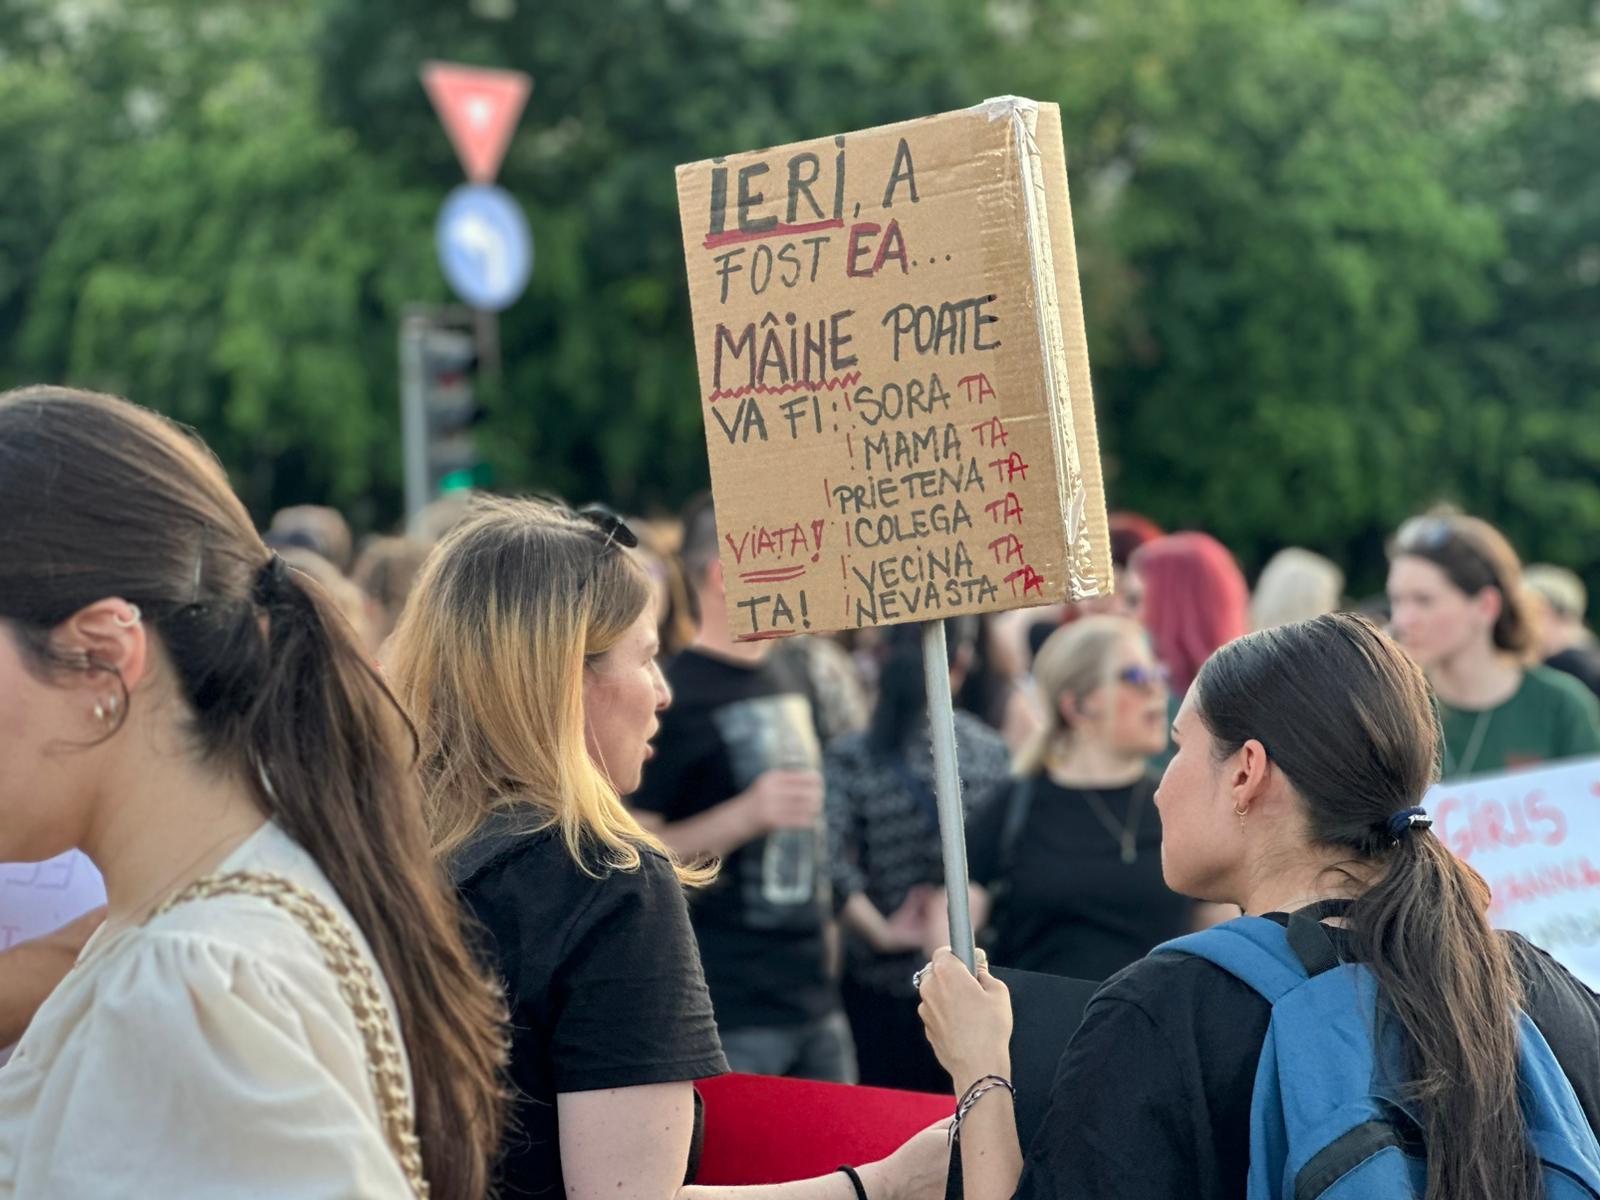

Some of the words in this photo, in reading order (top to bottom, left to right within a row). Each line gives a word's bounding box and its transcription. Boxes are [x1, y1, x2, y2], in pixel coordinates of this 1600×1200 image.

[882, 138, 920, 208] A
[713, 236, 830, 304] FOST
[881, 294, 1002, 362] POATE
[711, 397, 768, 444] VA
[957, 373, 996, 404] TA
[971, 416, 1009, 449] TA
[988, 452, 1029, 483] TA
[984, 492, 1023, 525] TA
[988, 533, 1024, 565] TA
[1003, 564, 1044, 598] TA
[737, 590, 811, 632] TA!
